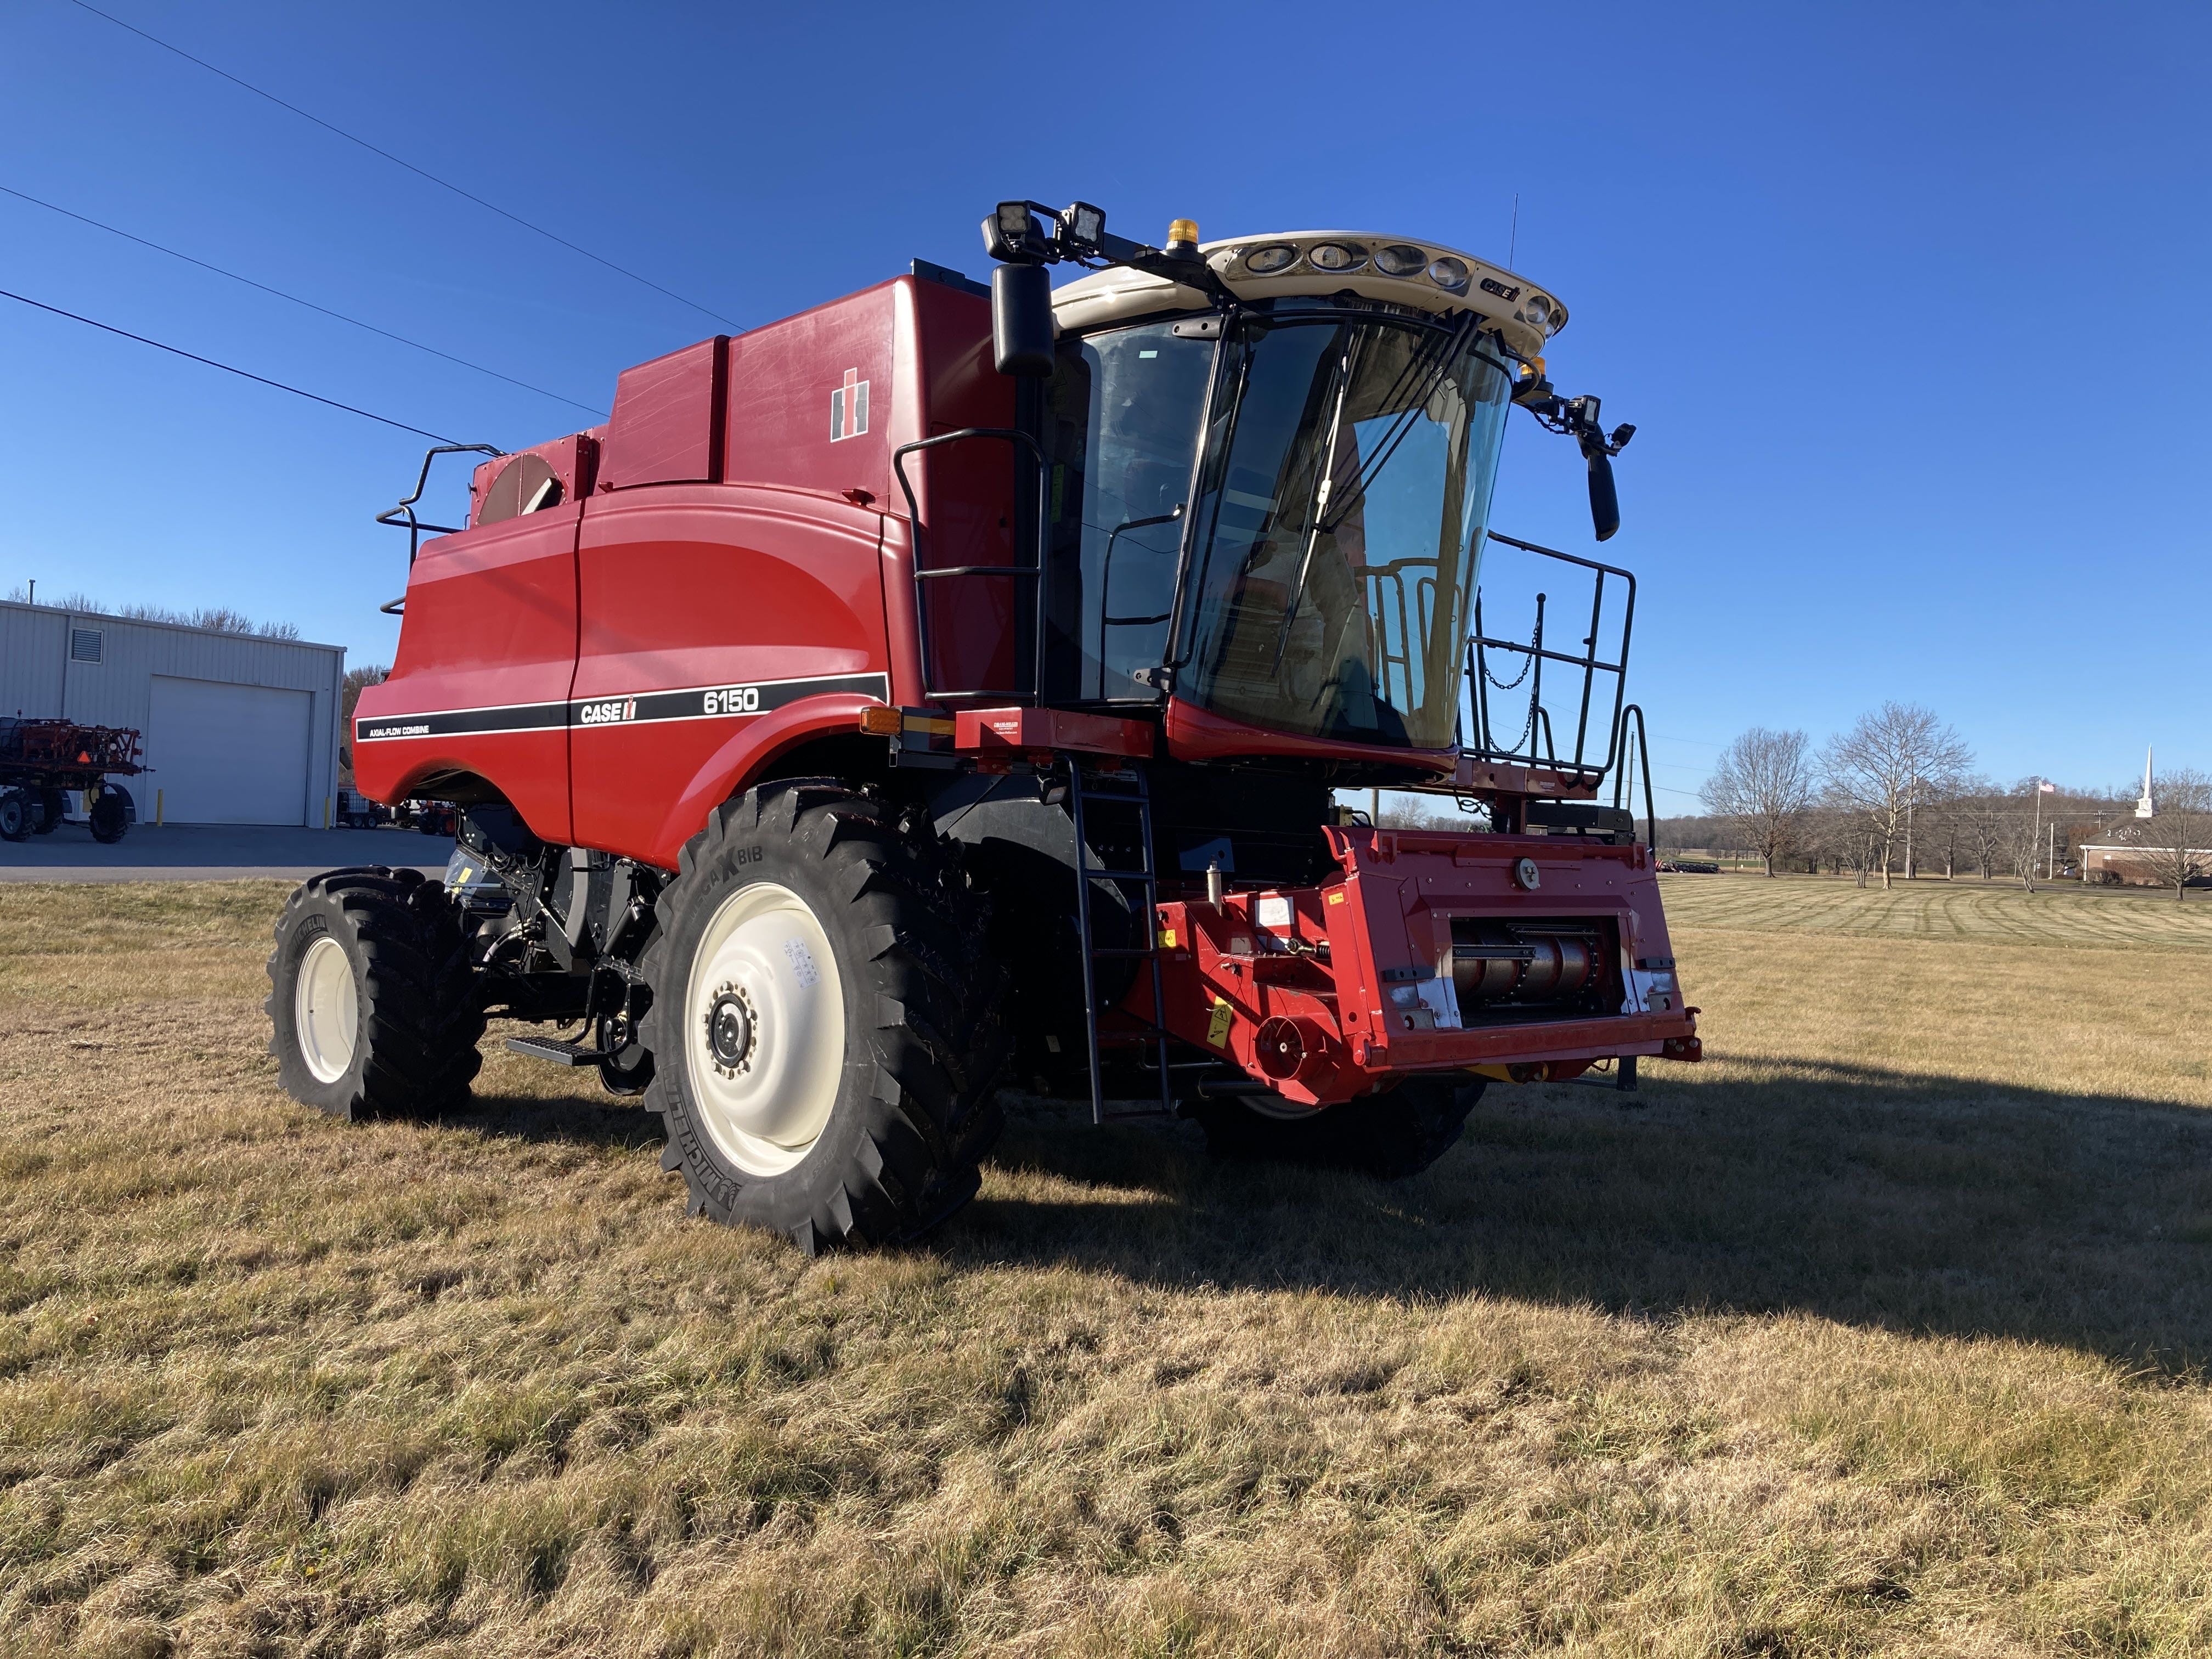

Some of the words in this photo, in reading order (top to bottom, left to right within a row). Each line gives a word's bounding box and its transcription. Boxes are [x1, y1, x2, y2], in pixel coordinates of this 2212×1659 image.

[1484, 280, 1511, 298] CASE
[703, 687, 759, 714] 6150
[580, 703, 622, 724] CASE
[369, 727, 401, 737] AXIAL-FLOW
[402, 725, 429, 735] COMBINE
[664, 1069, 720, 1193] MICHELIN
